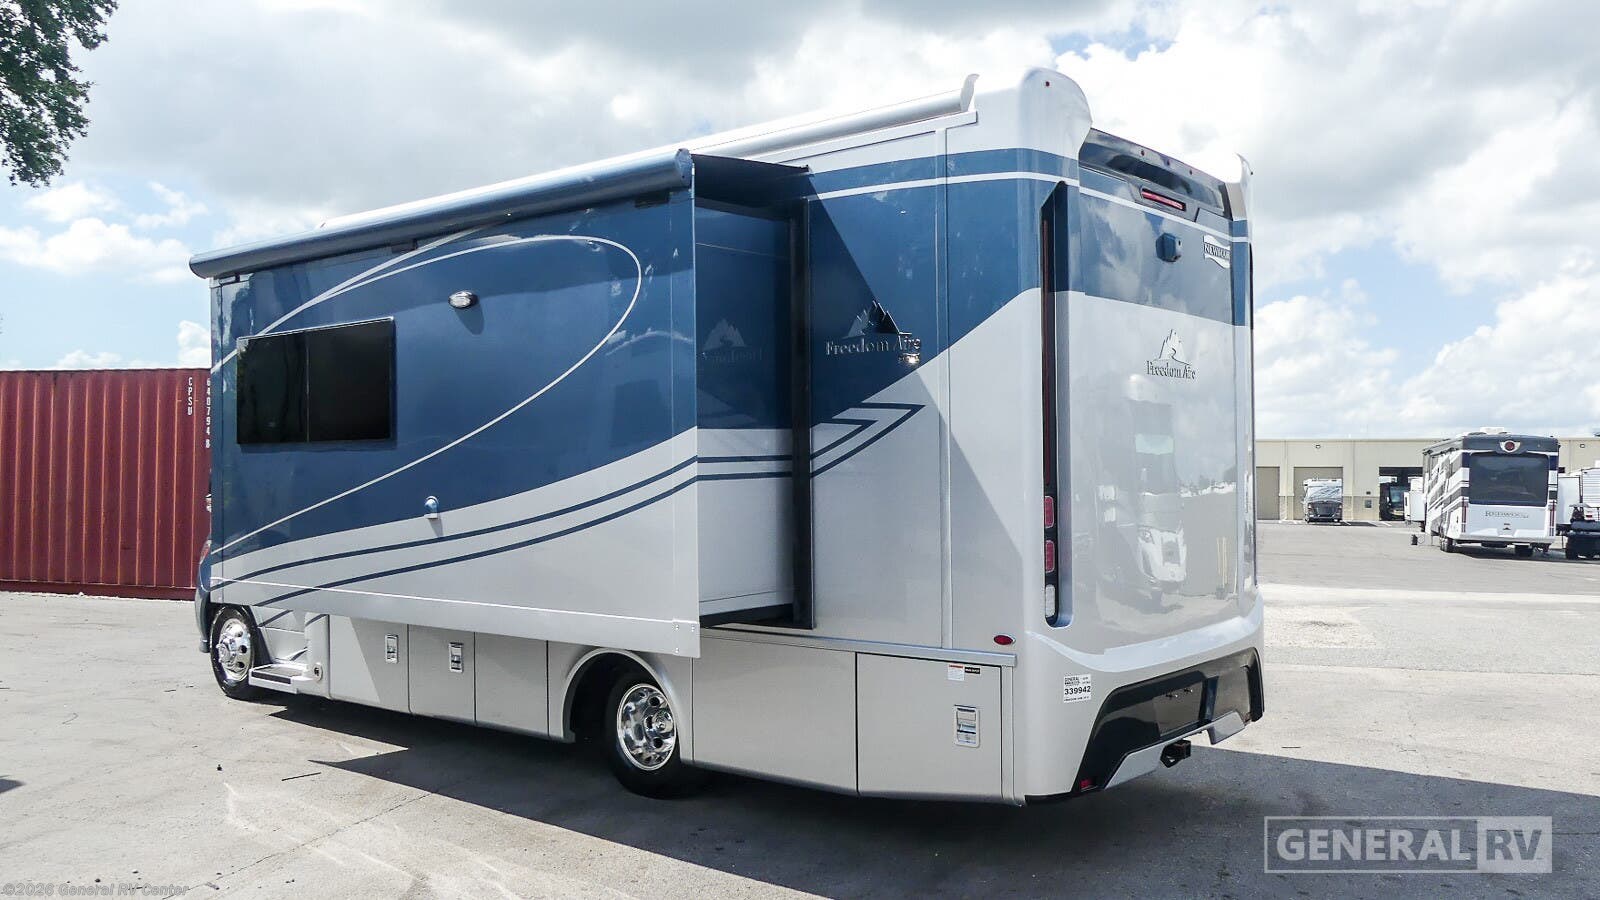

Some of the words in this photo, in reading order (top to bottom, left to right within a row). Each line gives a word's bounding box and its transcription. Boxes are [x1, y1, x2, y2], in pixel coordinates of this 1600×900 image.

[825, 337, 889, 355] Freedom
[893, 335, 921, 350] Aire
[1146, 360, 1181, 378] Freedom
[1064, 685, 1091, 695] 339942
